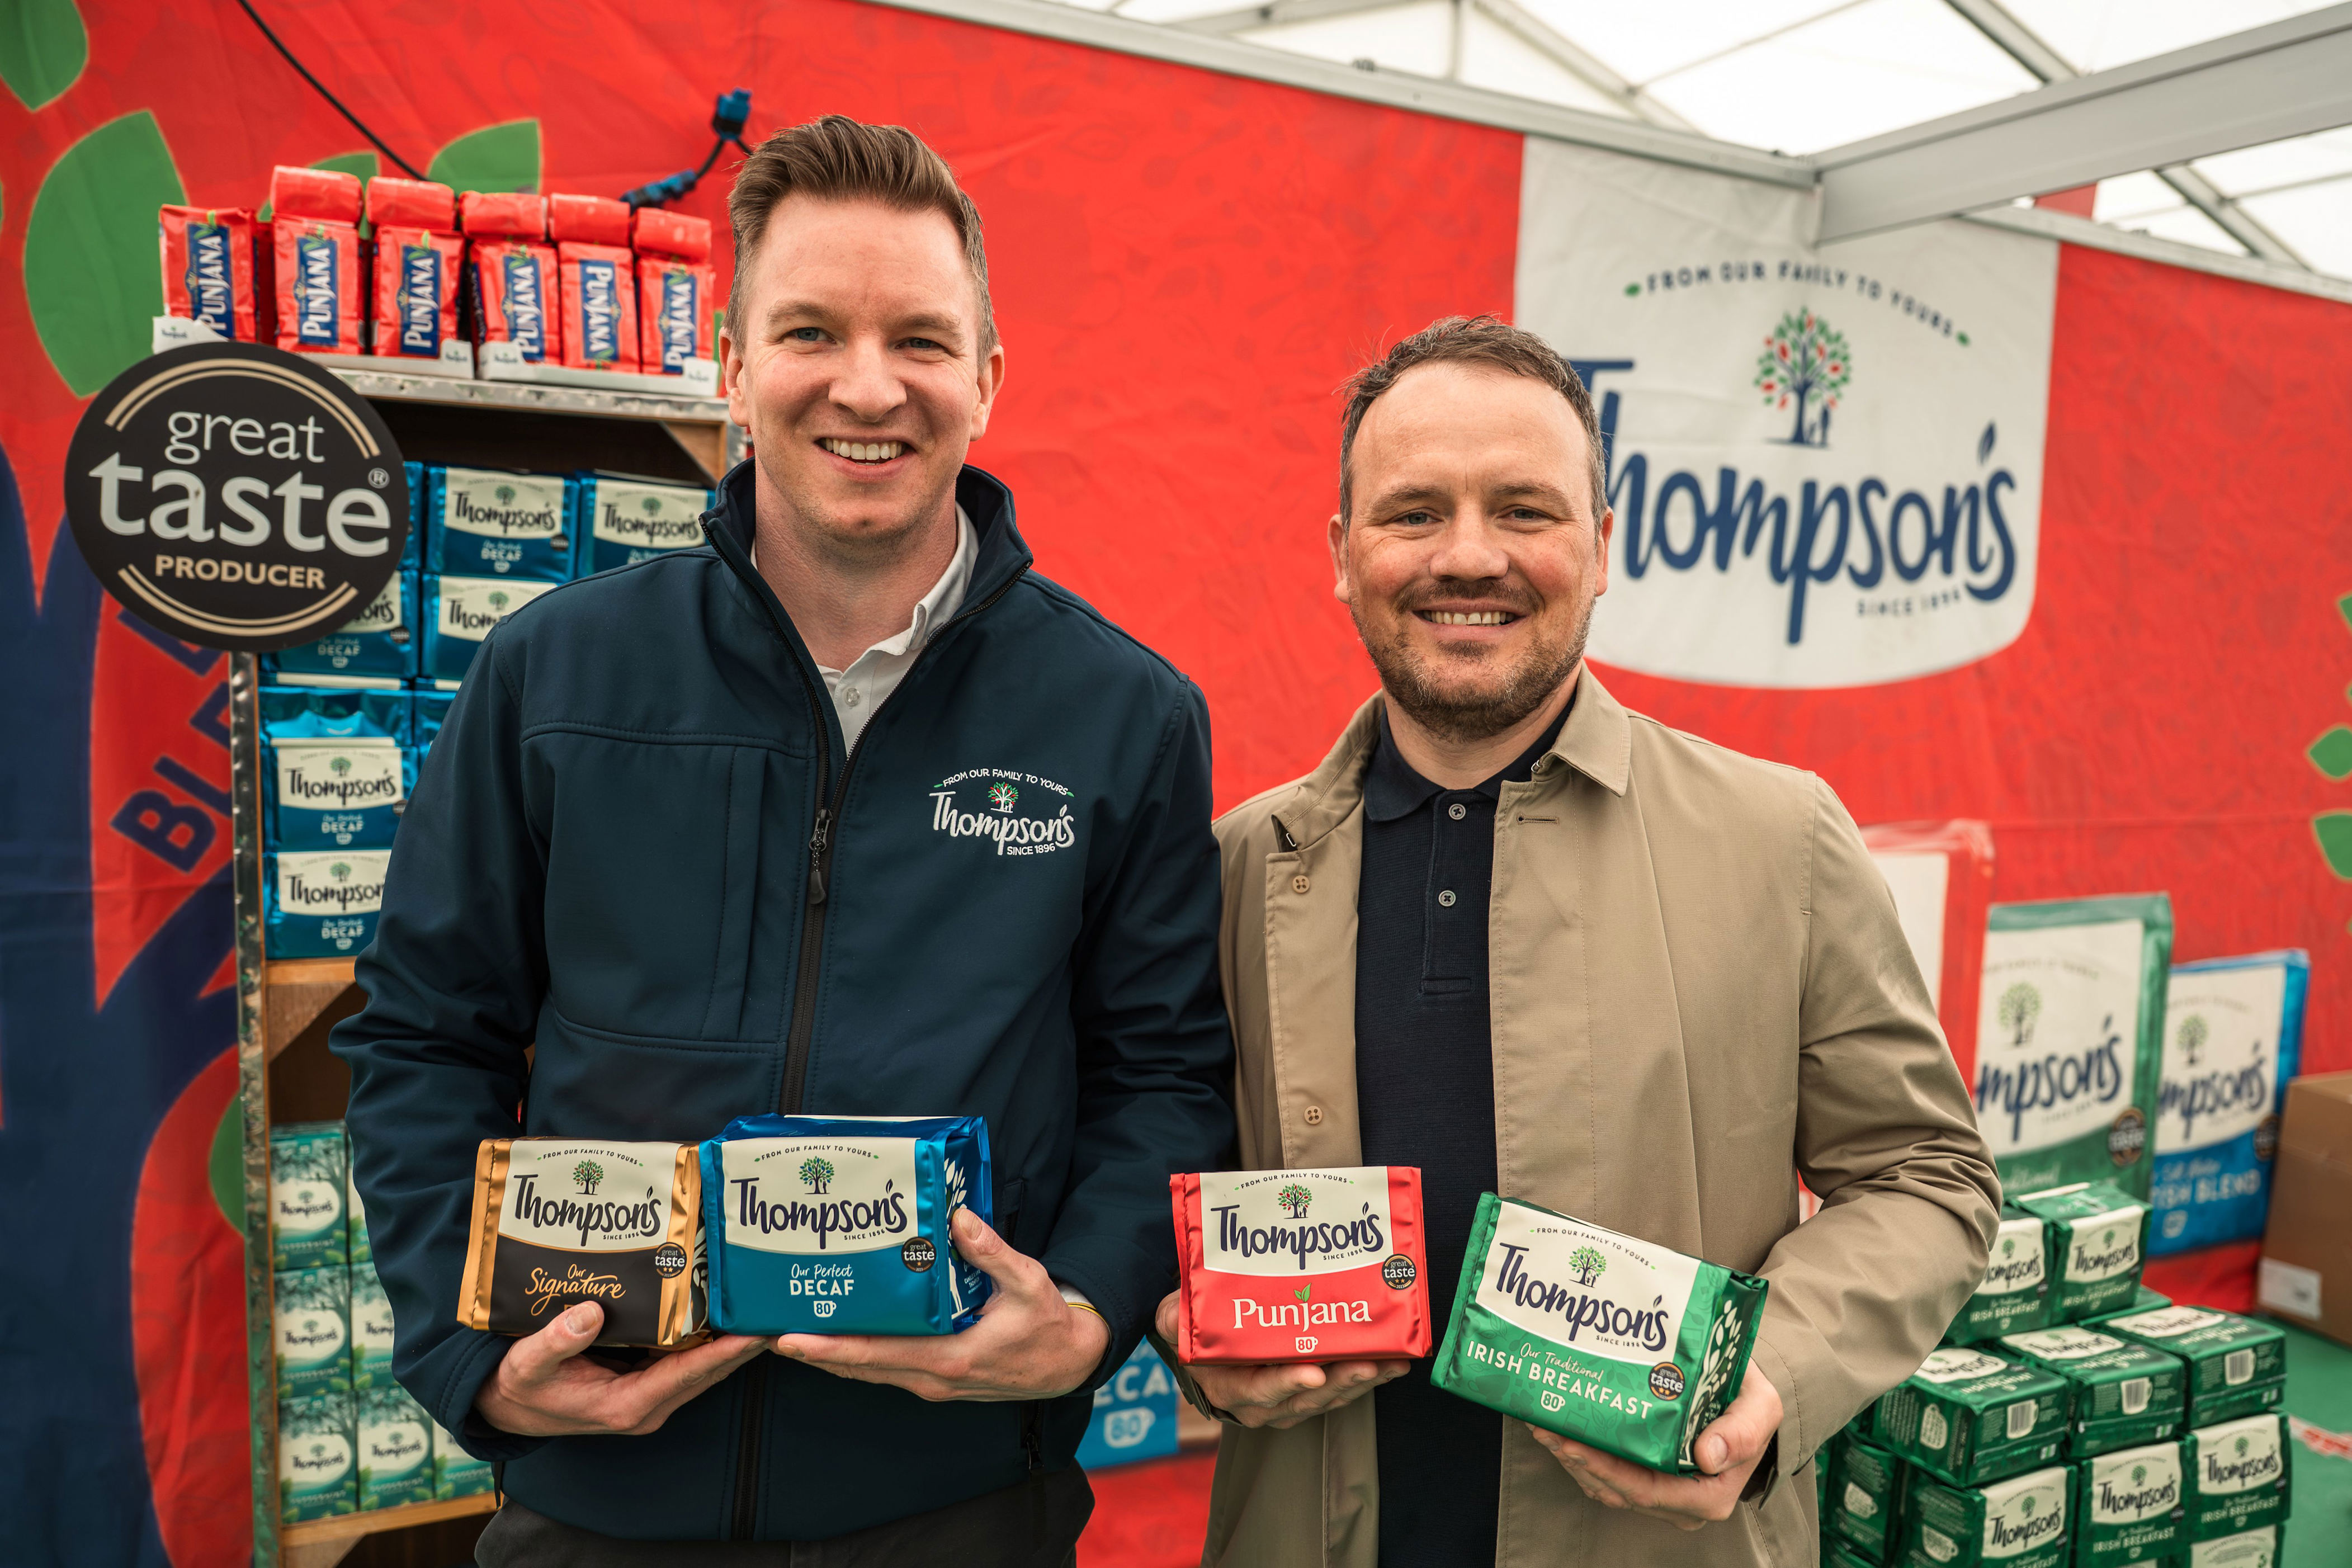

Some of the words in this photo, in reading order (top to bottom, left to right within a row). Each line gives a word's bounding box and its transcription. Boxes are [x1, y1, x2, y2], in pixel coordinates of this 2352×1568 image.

[301, 247, 337, 338] PUNJANA
[1647, 266, 1712, 294] FROM
[1720, 261, 1766, 282] OUR
[1857, 275, 1883, 301] TO
[1890, 289, 1954, 338] YOURS
[404, 257, 439, 348] PUNJANA
[583, 265, 613, 352] PUNJANA
[164, 410, 325, 465] great
[155, 554, 326, 589] PRODUCER
[284, 767, 397, 807] Thompson's
[942, 771, 968, 787] FROM
[969, 768, 990, 778] OUR
[992, 768, 1023, 781] FAMILY
[1026, 773, 1038, 784] TO
[1040, 778, 1068, 796] YOURS
[321, 821, 364, 834] DECAF
[929, 791, 1075, 856] Thompson's
[1007, 846, 1033, 856] SINCE
[1035, 843, 1056, 854] 1896
[543, 1151, 561, 1159] FROM
[617, 1153, 638, 1165] YOURS
[762, 1150, 782, 1160] FROM
[847, 1147, 872, 1158] YOURS
[1241, 1179, 1260, 1189] FROM
[1323, 1174, 1347, 1183] YOURS
[513, 1174, 662, 1246] Thompson's
[730, 1177, 908, 1250] Thompson's
[625, 1231, 640, 1240] 1896
[869, 1229, 885, 1239] 1896
[1210, 1201, 1384, 1270] Thompson's
[903, 1250, 935, 1261] taste
[1347, 1248, 1363, 1258] 1896
[1581, 1232, 1609, 1244] FAMILY
[1612, 1242, 1622, 1250] TO
[1624, 1248, 1650, 1267] YOURS
[655, 1255, 685, 1267] taste
[791, 1263, 810, 1278] Our
[814, 1263, 853, 1278] Perfect
[1390, 1260, 1408, 1269] great
[568, 1264, 587, 1279] Our
[1383, 1267, 1415, 1278] taste
[525, 1267, 626, 1316] Signature
[790, 1279, 854, 1296] DECAF
[1494, 1242, 1669, 1352] Thompson's
[816, 1303, 830, 1315] 80
[1232, 1297, 1372, 1332] Punjana
[1298, 1339, 1313, 1350] 80
[1596, 1335, 1619, 1345] SINCE
[1519, 1342, 1541, 1359] Our
[1545, 1349, 1604, 1382] Traditional
[1466, 1340, 1522, 1375] IRISH
[1528, 1362, 1652, 1419] BREAKFAST
[1651, 1372, 1684, 1394] taste
[1542, 1392, 1559, 1409] 80
